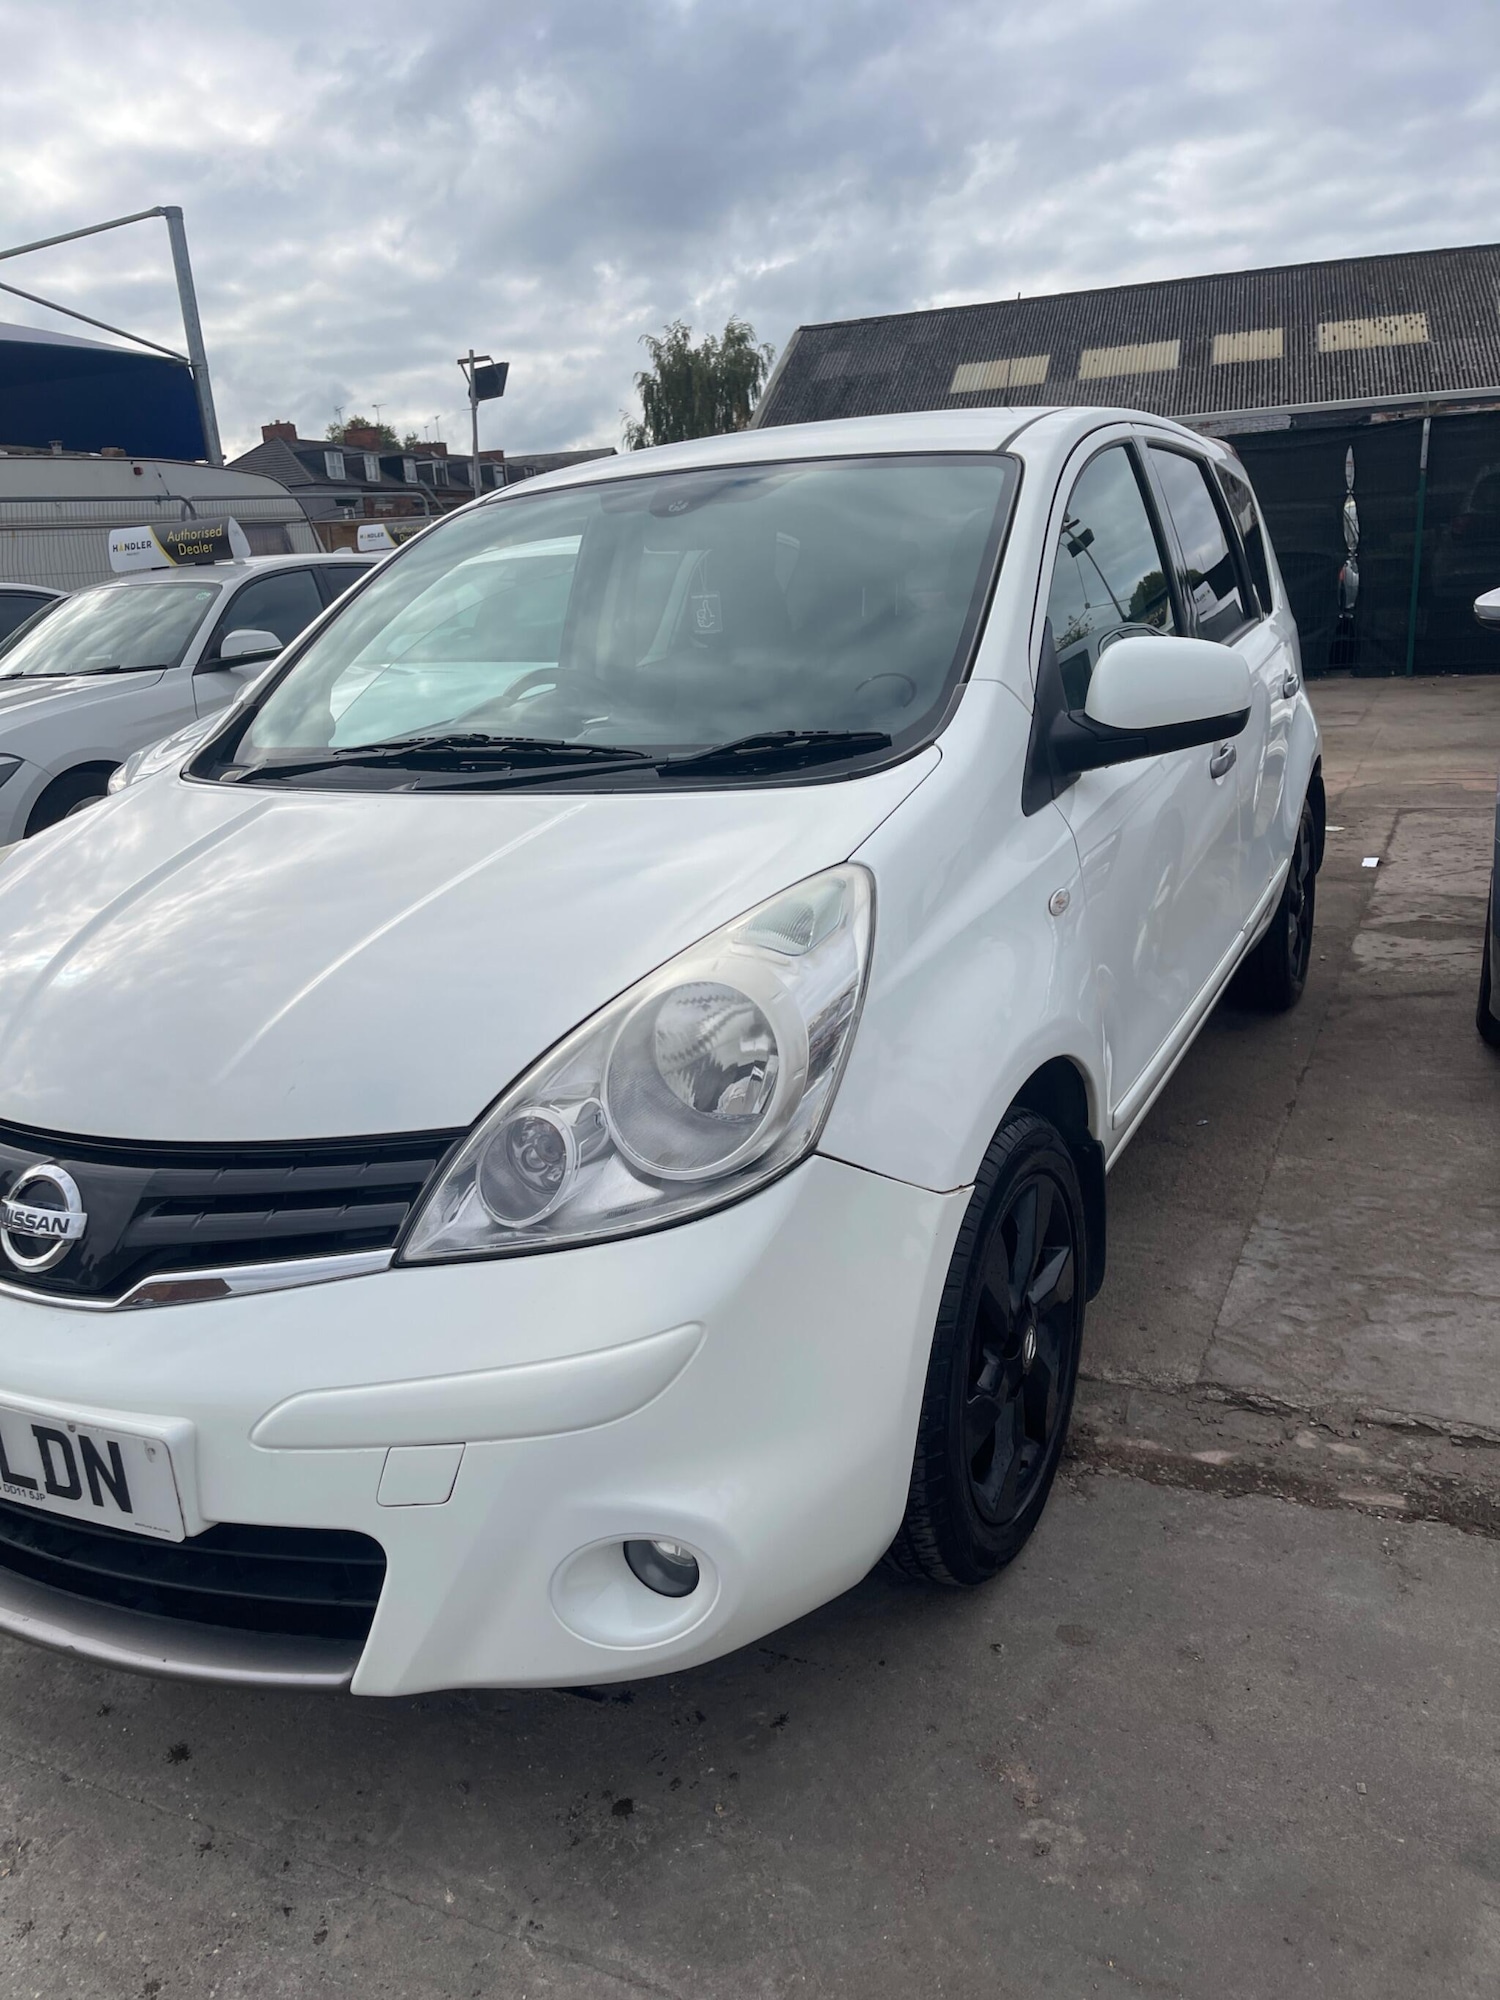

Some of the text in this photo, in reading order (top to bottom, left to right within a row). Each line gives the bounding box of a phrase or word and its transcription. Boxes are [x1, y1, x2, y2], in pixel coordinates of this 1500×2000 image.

[166, 524, 223, 542] Authorised
[112, 540, 152, 553] HANDLER
[178, 541, 213, 556] Dealer
[3, 1483, 46, 1501] DD11 5JP
